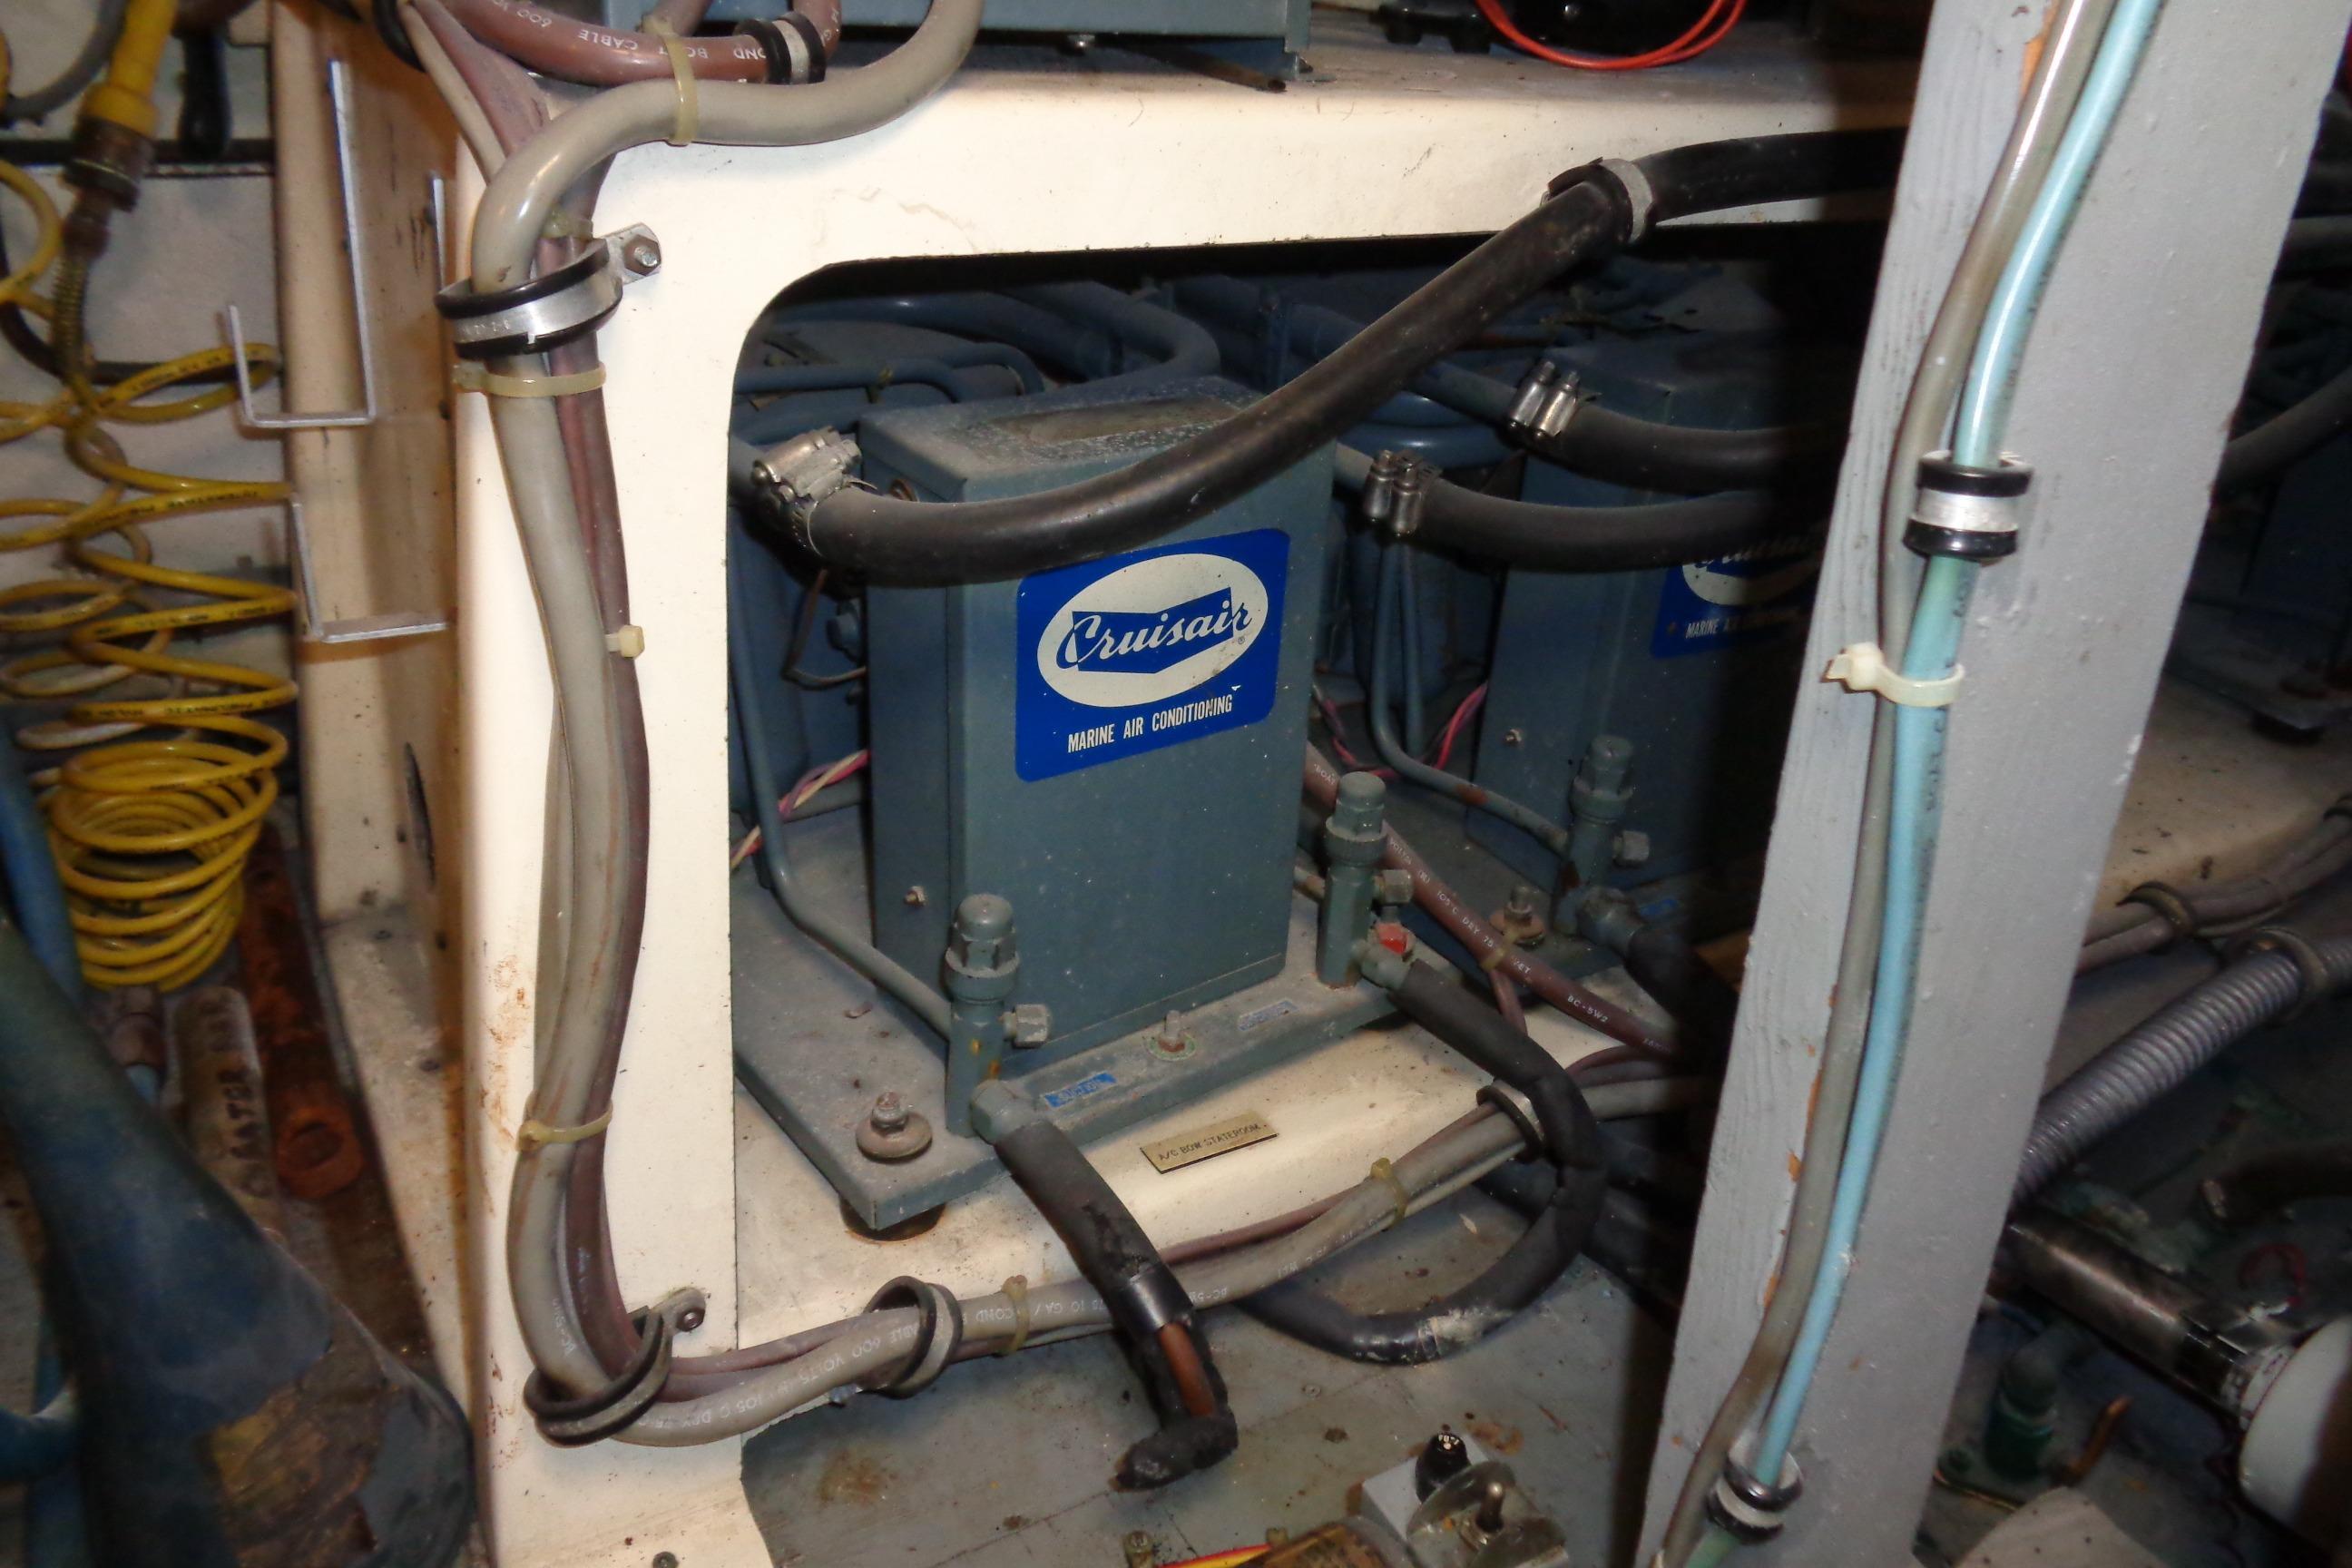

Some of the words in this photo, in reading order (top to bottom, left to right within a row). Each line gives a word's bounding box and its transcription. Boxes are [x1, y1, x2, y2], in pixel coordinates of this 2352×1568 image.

[516, 8, 553, 28] 600
[578, 28, 639, 51] CABLE
[1055, 599, 1252, 670] Cruisair
[1685, 617, 1721, 639] MARINE
[1067, 724, 1115, 753] MARINE
[1123, 716, 1144, 740] AIR
[1152, 694, 1233, 732] CONDITIONING
[1462, 916, 1481, 935] DRY
[1180, 1142, 1203, 1155] BOW
[1203, 1122, 1261, 1146] STATEROOM
